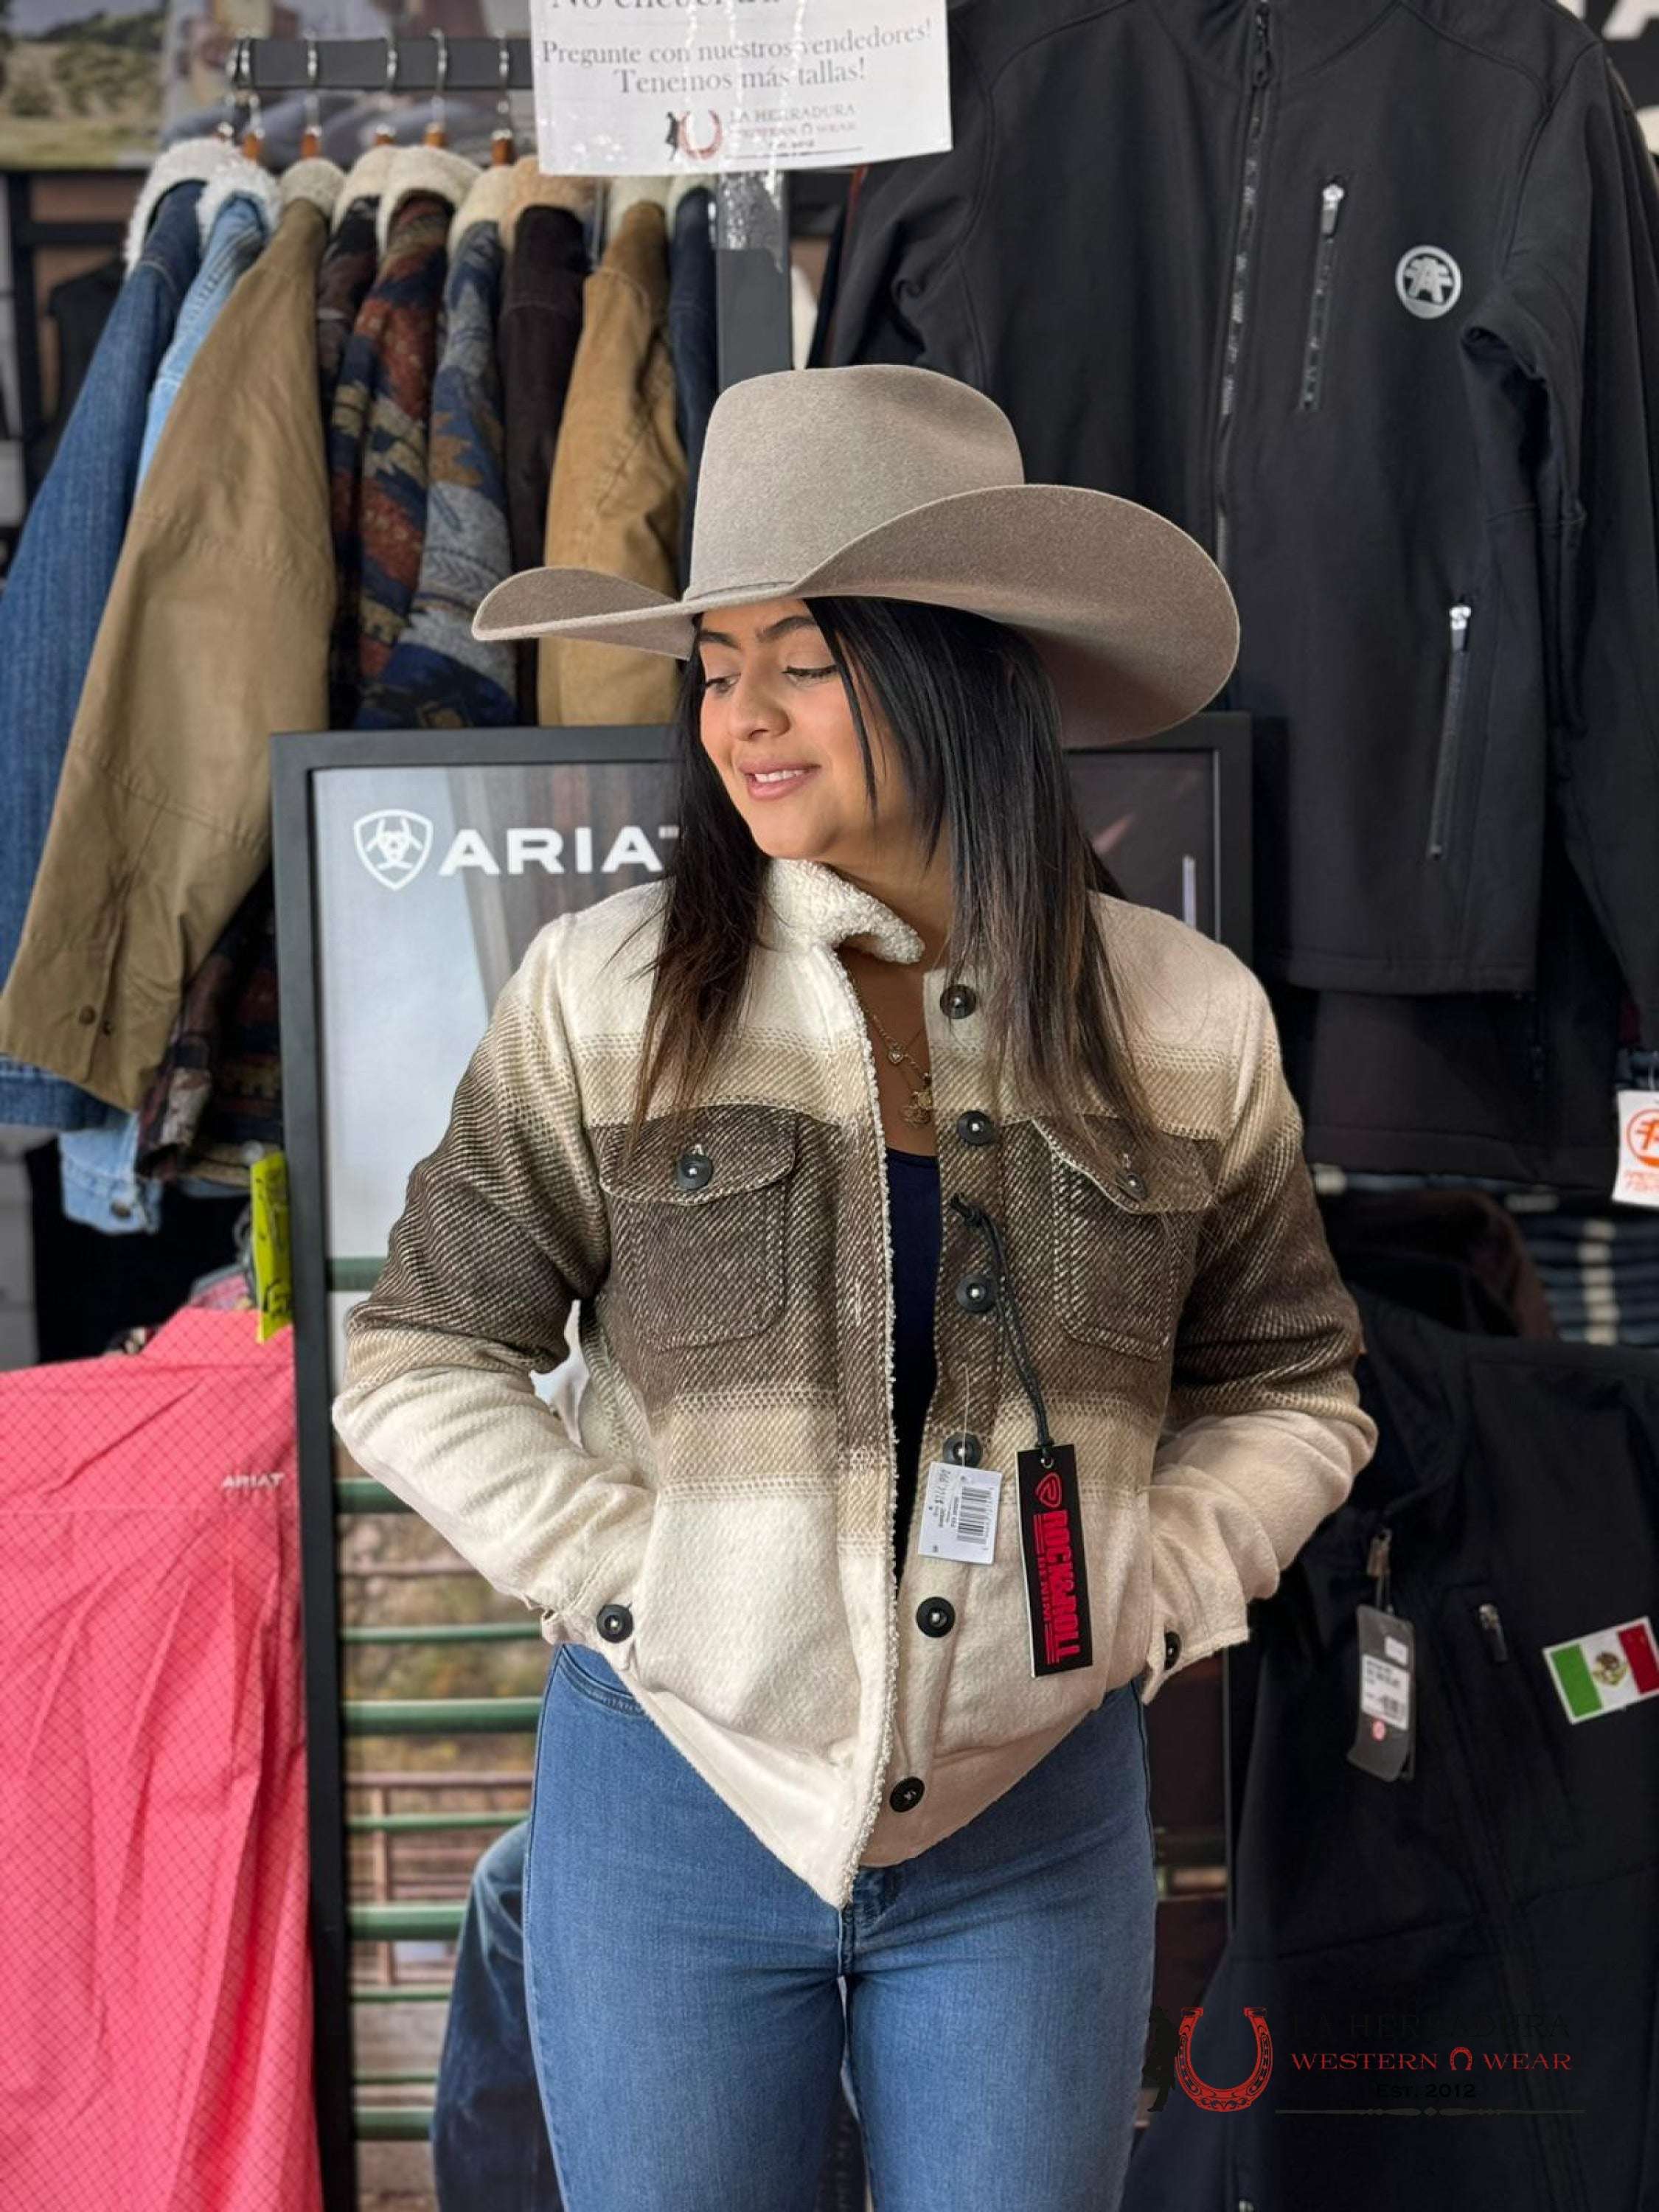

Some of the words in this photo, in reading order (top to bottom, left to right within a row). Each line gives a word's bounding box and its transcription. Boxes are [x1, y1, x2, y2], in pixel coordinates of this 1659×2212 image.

[542, 40, 641, 68] Pregunte
[649, 46, 689, 63] con
[698, 41, 792, 61] nuestros
[799, 18, 932, 55] vendedores!
[613, 69, 732, 94] Tenemos
[741, 65, 790, 89] más
[797, 57, 866, 86] tallas!
[755, 104, 855, 122] HERADURA
